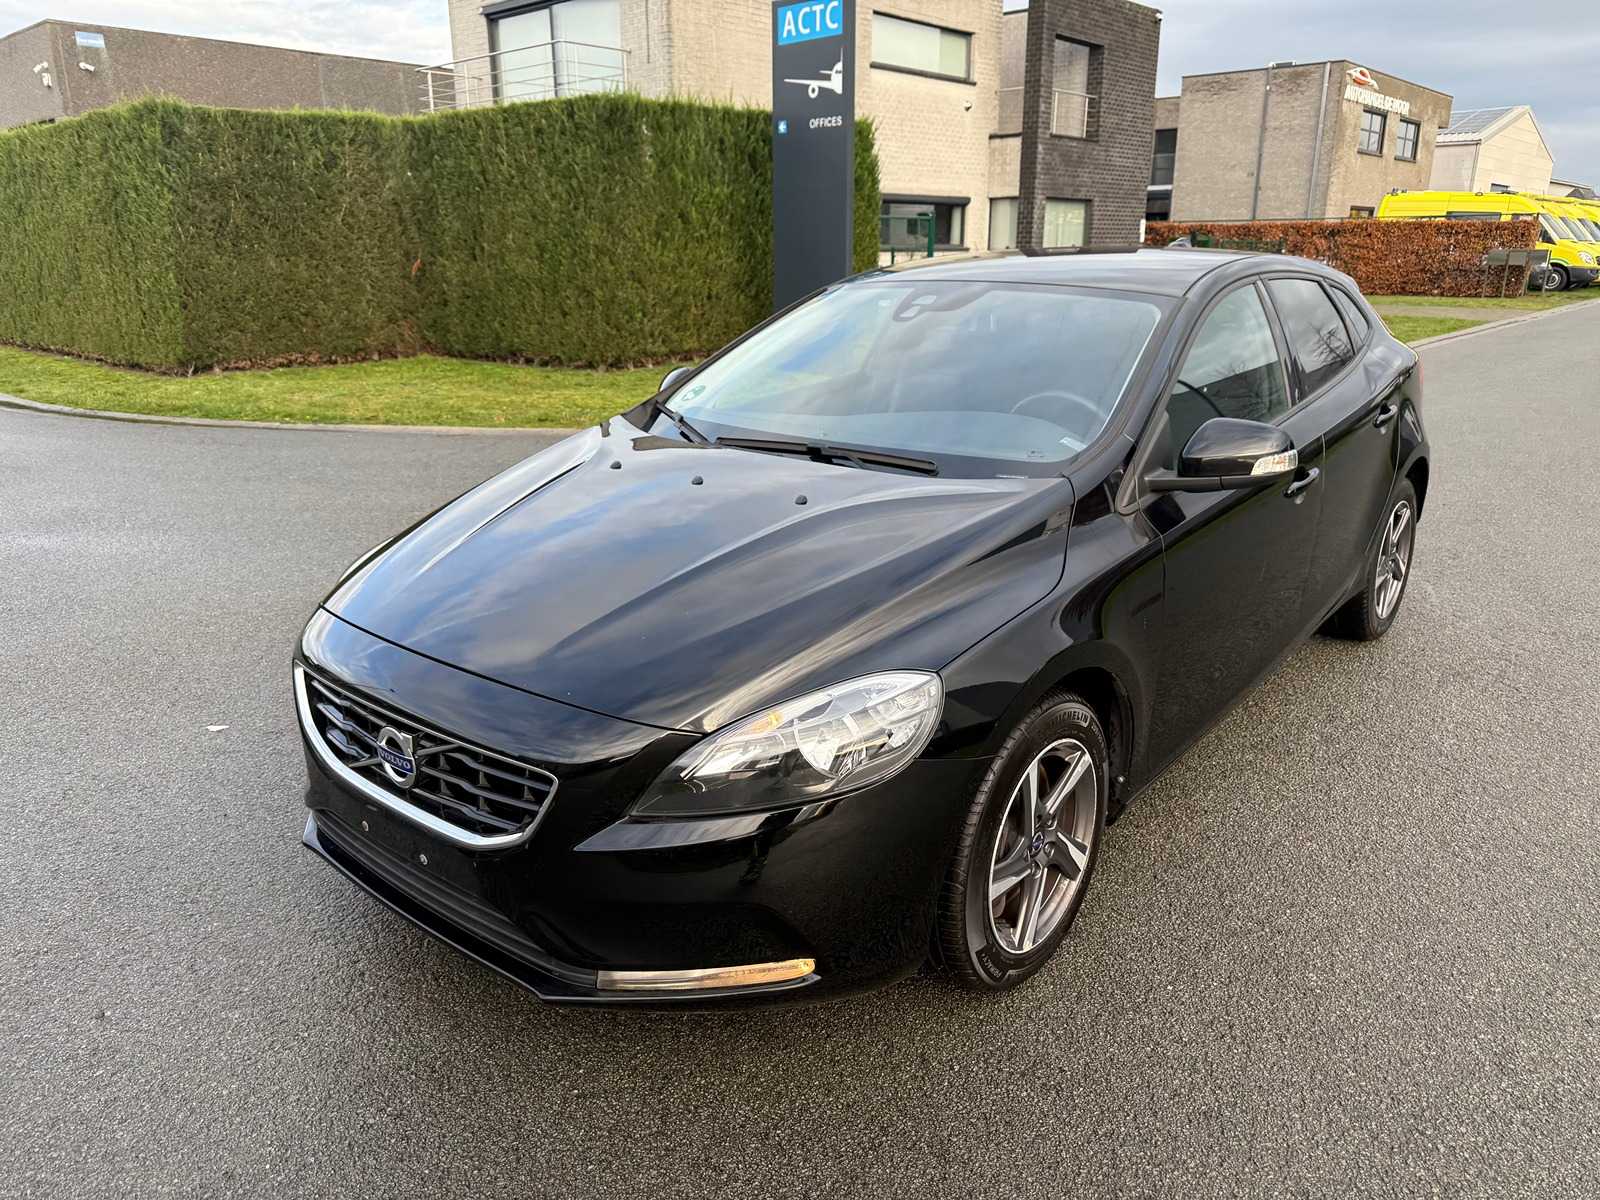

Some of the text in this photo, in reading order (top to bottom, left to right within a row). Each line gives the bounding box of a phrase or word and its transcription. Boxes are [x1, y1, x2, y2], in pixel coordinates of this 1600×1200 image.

[782, 1, 839, 38] ACTC
[809, 115, 842, 129] OFFICES
[380, 750, 411, 769] VOLVO
